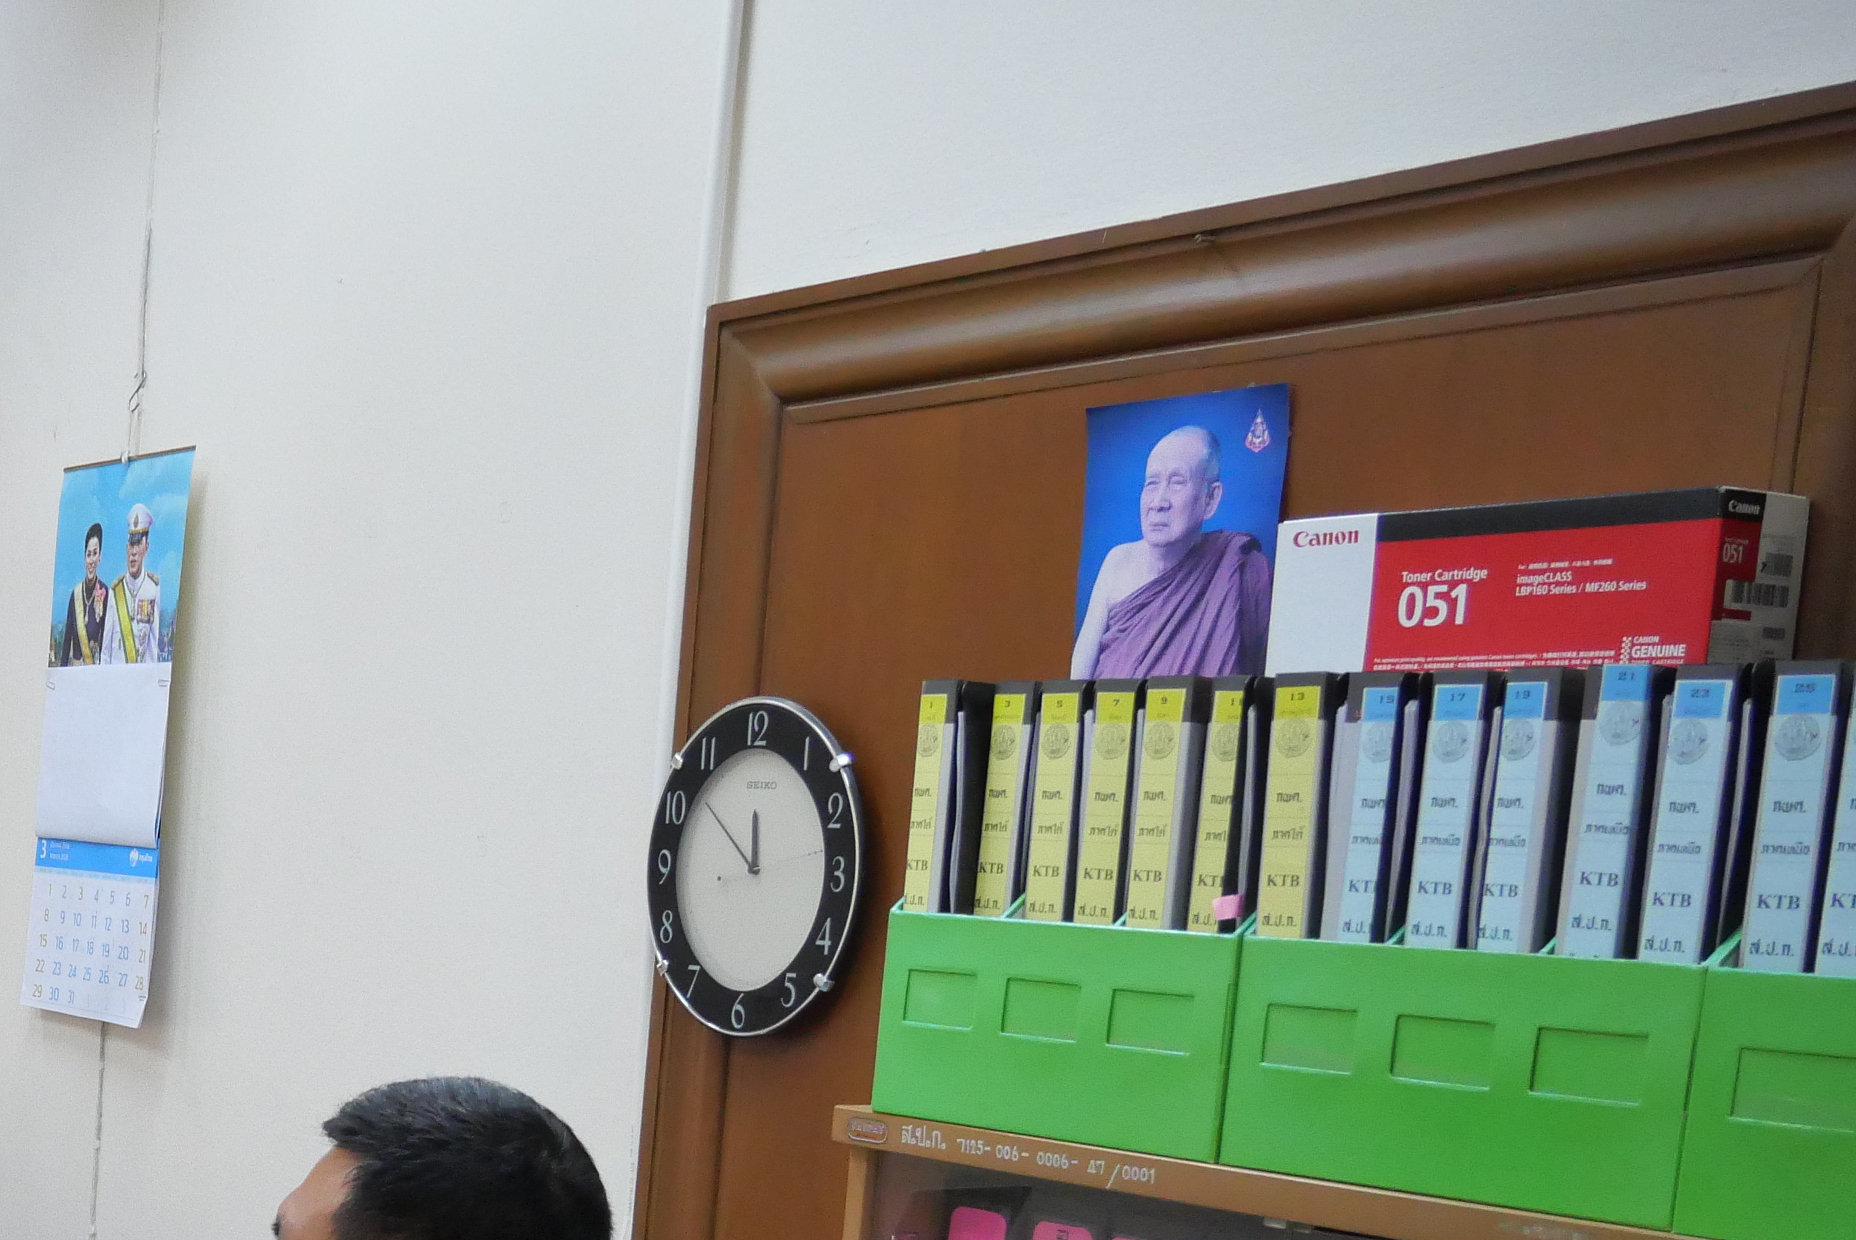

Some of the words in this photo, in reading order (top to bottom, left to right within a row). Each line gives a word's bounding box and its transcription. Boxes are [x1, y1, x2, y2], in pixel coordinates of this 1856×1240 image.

[1728, 500, 1760, 514] Canon
[1293, 530, 1359, 547] Canon
[1722, 544, 1744, 563] 051
[1402, 570, 1432, 582] Toner
[1435, 568, 1487, 582] Cartridge
[1516, 572, 1572, 585] imageCLASS
[1516, 586, 1548, 596] LBP160
[1550, 583, 1577, 594] Series
[1586, 582, 1616, 592] MF260
[1618, 580, 1646, 591] Series
[1398, 583, 1468, 628] 051
[1632, 644, 1686, 658] GENUINE
[1618, 672, 1634, 680] 21
[1450, 692, 1465, 701] 17
[1515, 691, 1530, 699] 19
[747, 711, 768, 746] 12
[701, 737, 715, 770] 11
[803, 737, 809, 770] 1
[747, 781, 777, 789] SEIKO
[665, 791, 685, 824] 10
[827, 793, 843, 829] 2
[40, 839, 46, 858] 3
[658, 850, 671, 884] 9
[906, 860, 928, 871] KTB
[979, 862, 1004, 874] KTB
[1033, 865, 1059, 877] KTB
[830, 856, 844, 892] 3
[1083, 868, 1113, 880] KTB
[1133, 869, 1162, 882] KTB
[1266, 875, 1299, 887] KTB
[1579, 872, 1619, 887] KTB
[1348, 880, 1376, 892] KT
[1417, 882, 1452, 895] KTB
[1484, 883, 1519, 897] KTB
[62, 885, 66, 898] 2
[79, 887, 83, 900] 3
[95, 889, 99, 902] 4
[110, 891, 114, 904] 5
[126, 893, 130, 906] 6
[144, 895, 149, 908] 7
[1652, 892, 1691, 907] KTB
[1756, 894, 1800, 909] KTB
[44, 909, 49, 921] 8
[61, 911, 65, 924] 9
[73, 913, 81, 926] 10
[92, 916, 97, 928] 11
[105, 918, 112, 931] 12
[122, 920, 129, 933] 13
[139, 922, 147, 935] 14
[660, 910, 673, 943] 8
[815, 918, 831, 955] 4
[40, 934, 47, 947] 15
[56, 937, 63, 949] 16
[73, 939, 79, 952] 17
[87, 942, 93, 955] 18
[102, 944, 109, 957] 19
[118, 946, 128, 960] 20
[35, 959, 45, 972] 22
[52, 962, 61, 975] 23
[68, 965, 76, 978] 24
[99, 970, 109, 984] 26
[118, 973, 128, 987] 27
[135, 976, 143, 990] 28
[687, 965, 700, 997] 7
[33, 984, 42, 997] 29
[49, 987, 59, 1000] 30
[68, 990, 74, 1003] 31
[780, 973, 796, 1007] 5
[731, 993, 744, 1029] 6
